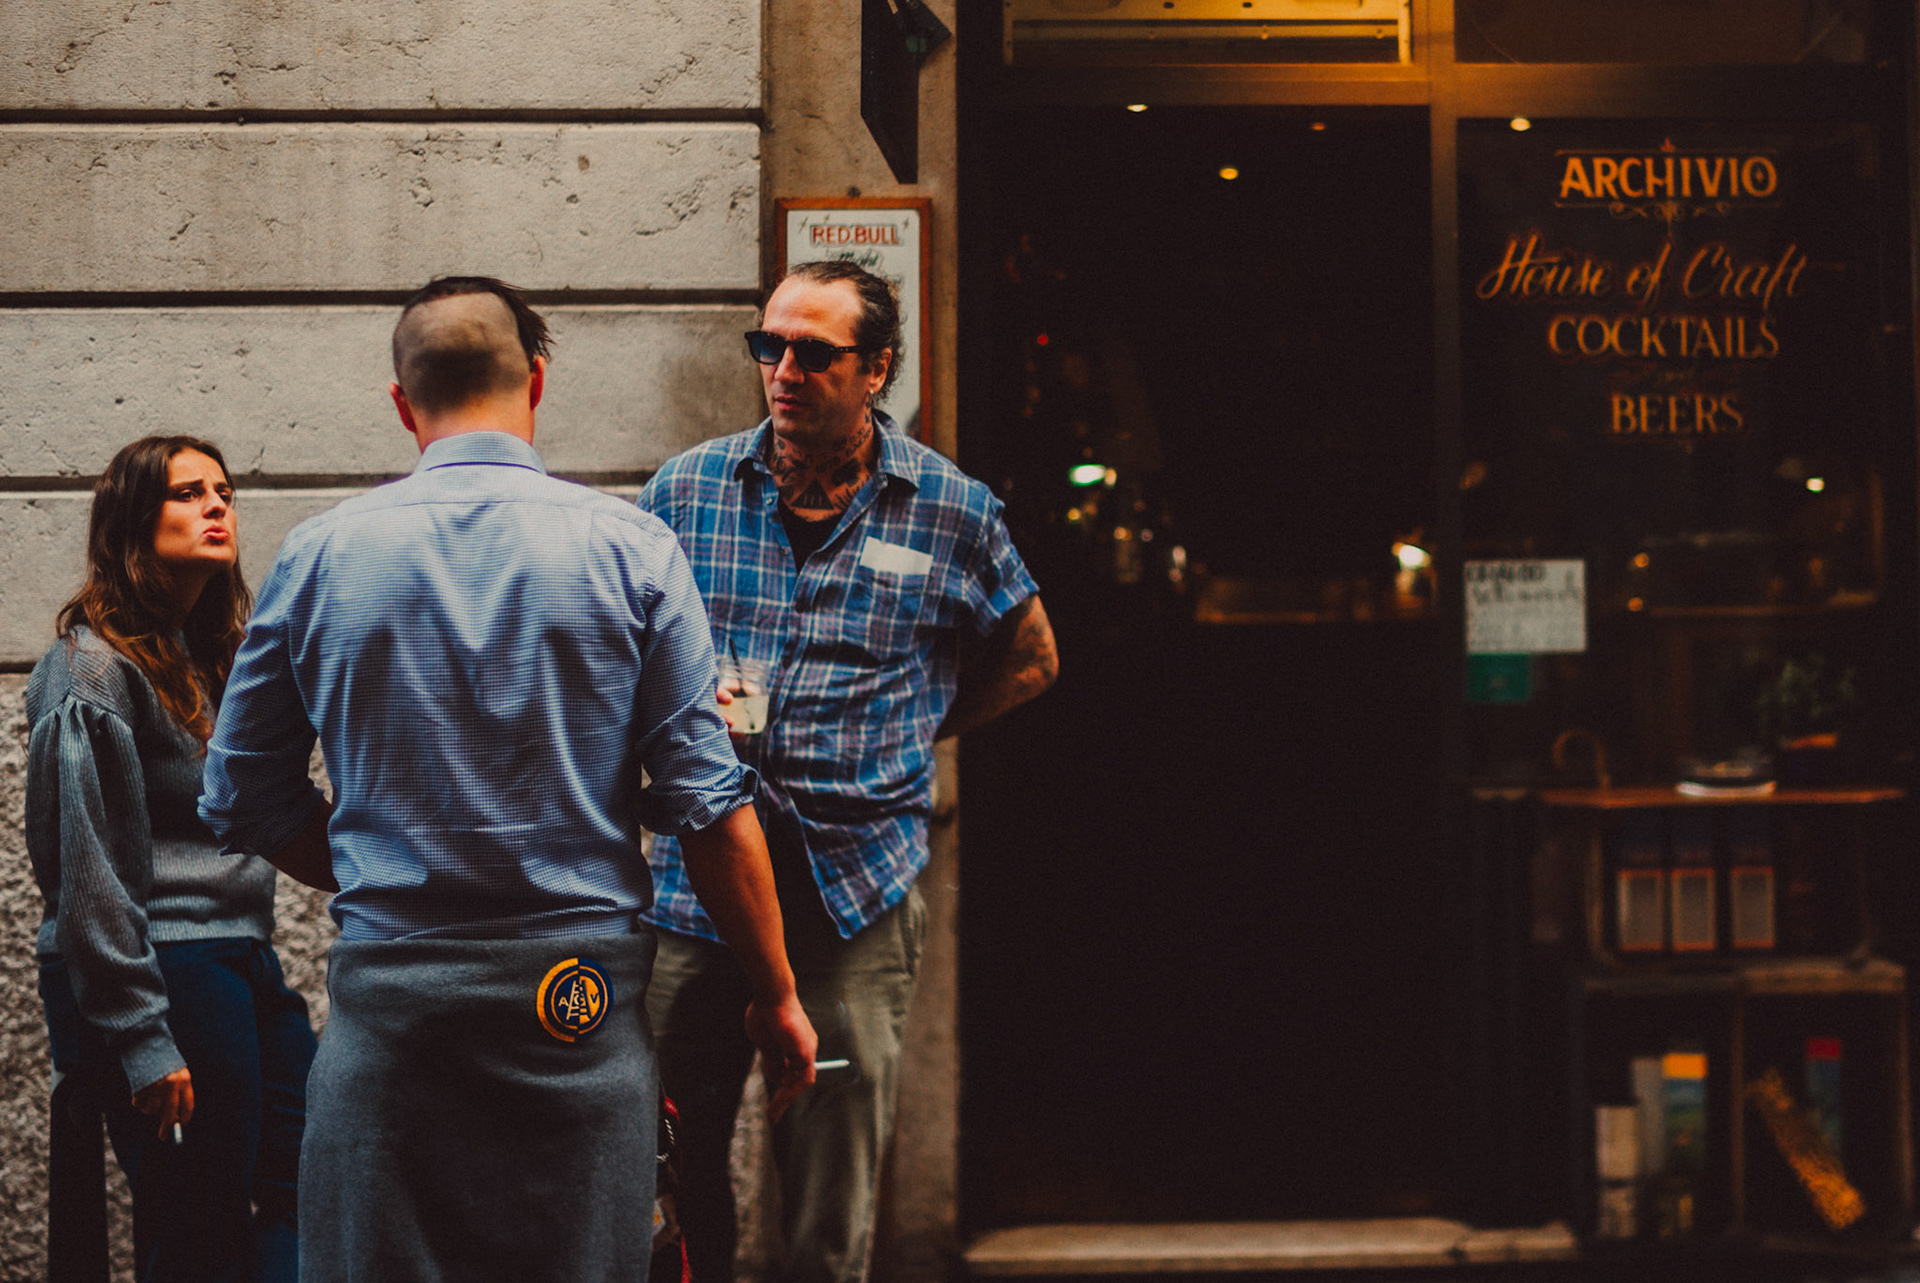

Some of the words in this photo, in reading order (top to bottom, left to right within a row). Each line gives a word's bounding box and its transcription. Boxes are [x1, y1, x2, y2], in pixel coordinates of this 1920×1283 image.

[1560, 157, 1778, 198] ARCHIVIO
[811, 224, 851, 245] RED
[853, 224, 901, 245] BULL
[1477, 234, 1612, 299] House
[1625, 242, 1672, 307] of
[1682, 243, 1807, 310] Craft
[1548, 314, 1779, 358] COCKTAILS
[1611, 392, 1744, 434] BEERS
